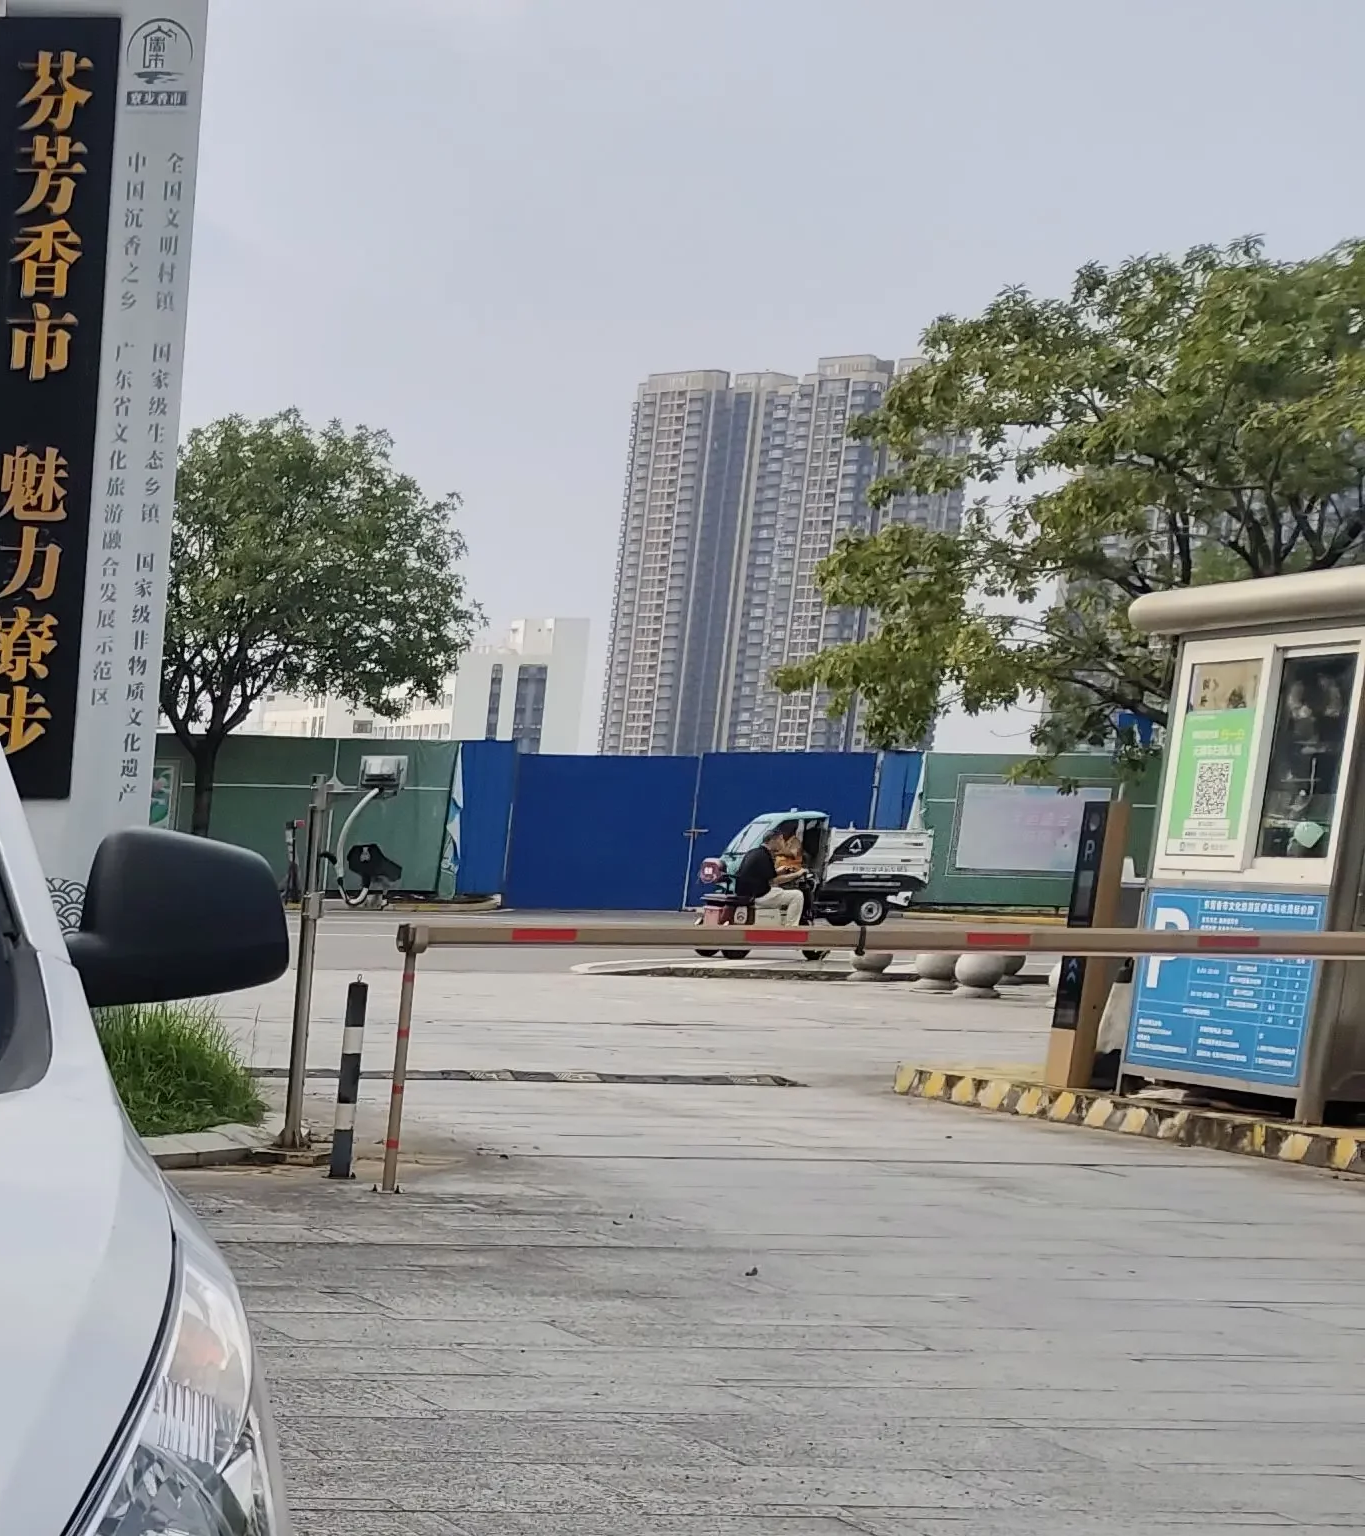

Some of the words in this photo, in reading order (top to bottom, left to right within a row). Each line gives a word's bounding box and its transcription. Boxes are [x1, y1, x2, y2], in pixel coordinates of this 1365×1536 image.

[6, 50, 94, 381] 芬芳香市
[121, 152, 147, 311] 中国沉香之乡
[156, 152, 184, 312] 全国文明村镇
[91, 342, 135, 706] 广东省文化旅游融合发展示范区
[141, 342, 171, 524] 国家级生态乡镇
[118, 553, 154, 802] 国家级非物质文化遗产
